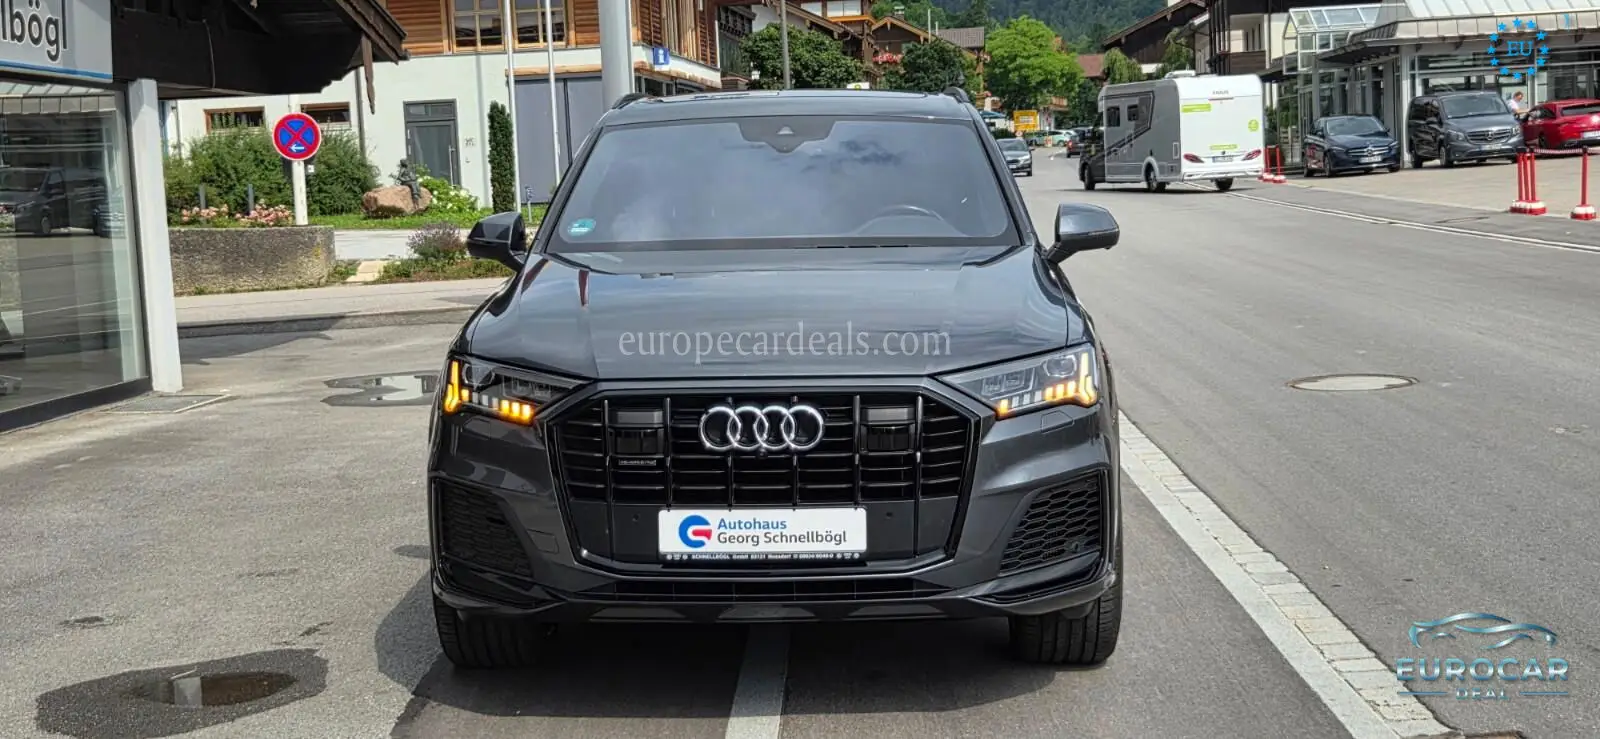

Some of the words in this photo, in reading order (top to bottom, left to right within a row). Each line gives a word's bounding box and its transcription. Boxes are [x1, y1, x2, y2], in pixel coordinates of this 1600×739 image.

[717, 518, 787, 530] Autohaus
[717, 532, 760, 546] Georg
[764, 530, 847, 546] Schnellbögl
